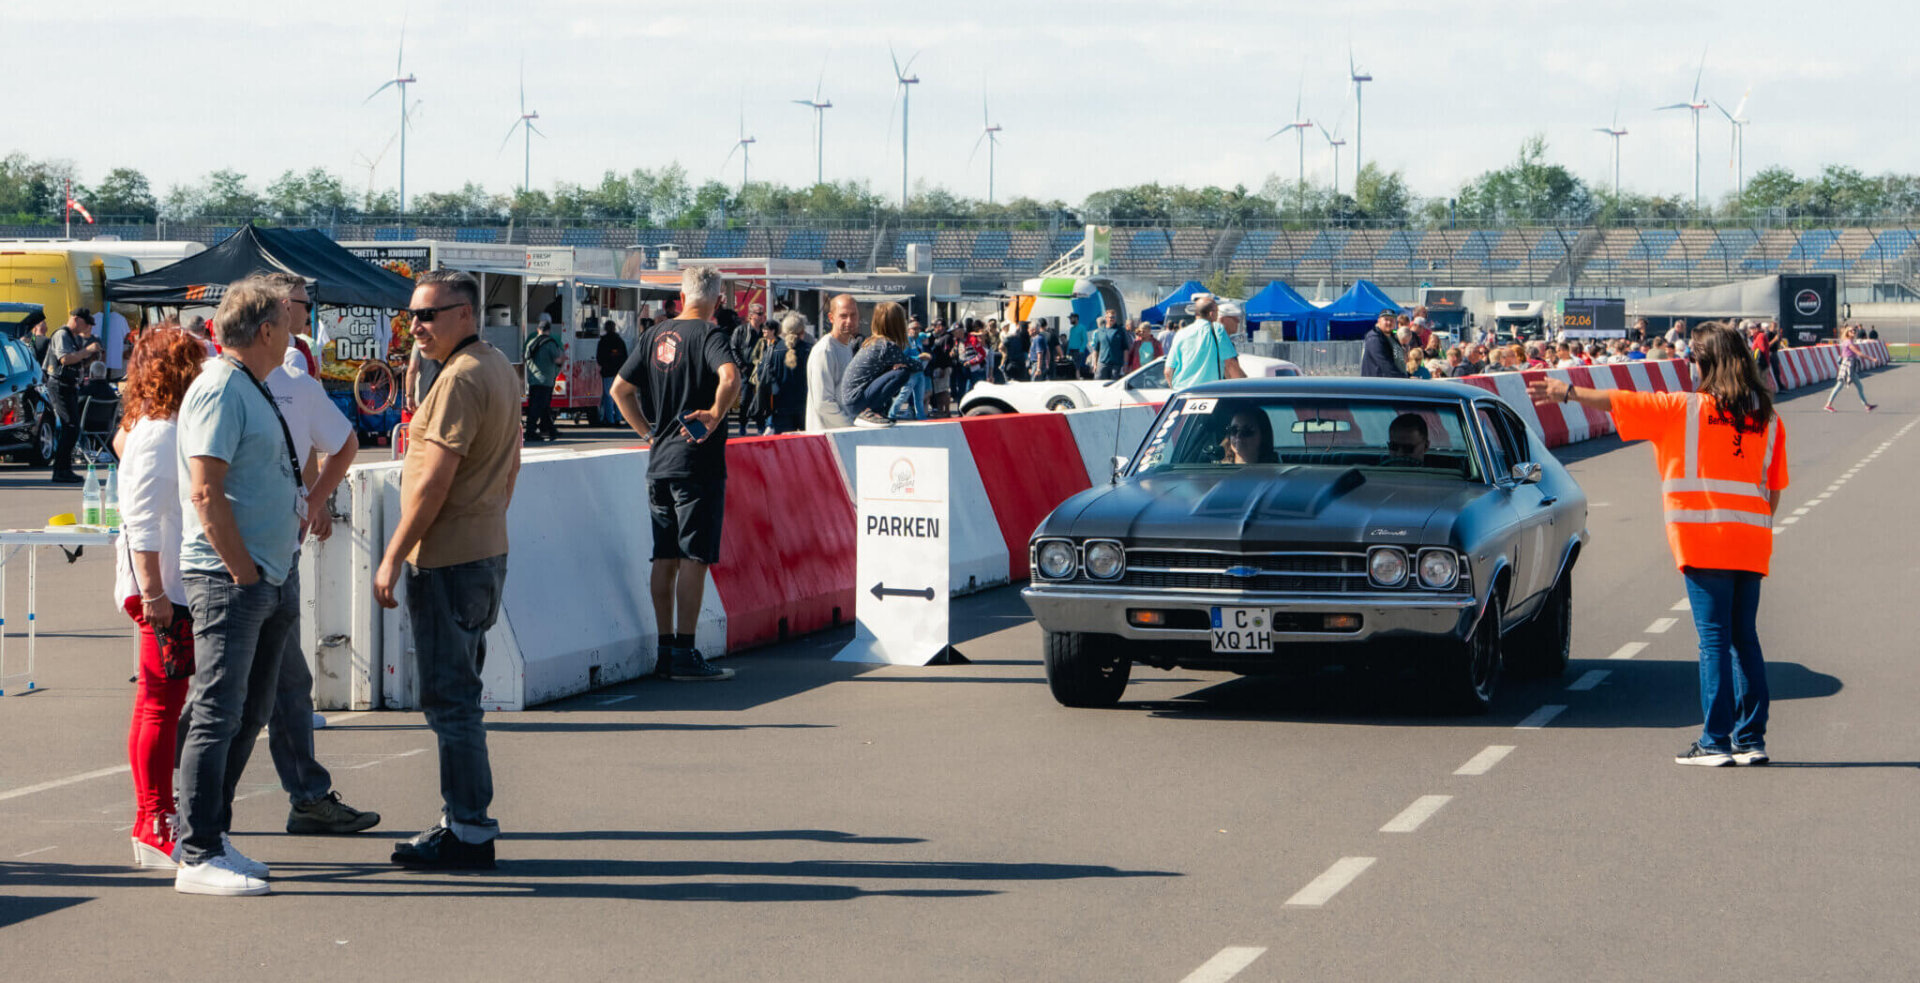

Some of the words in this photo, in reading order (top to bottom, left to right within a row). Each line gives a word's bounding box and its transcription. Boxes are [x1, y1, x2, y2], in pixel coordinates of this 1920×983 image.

[349, 320, 376, 336] den
[336, 337, 381, 360] Duft
[1189, 402, 1208, 410] 46
[867, 515, 939, 538] PARKEN
[1235, 610, 1248, 628] C
[1214, 631, 1240, 649] XQ
[1245, 631, 1271, 649] 1H
